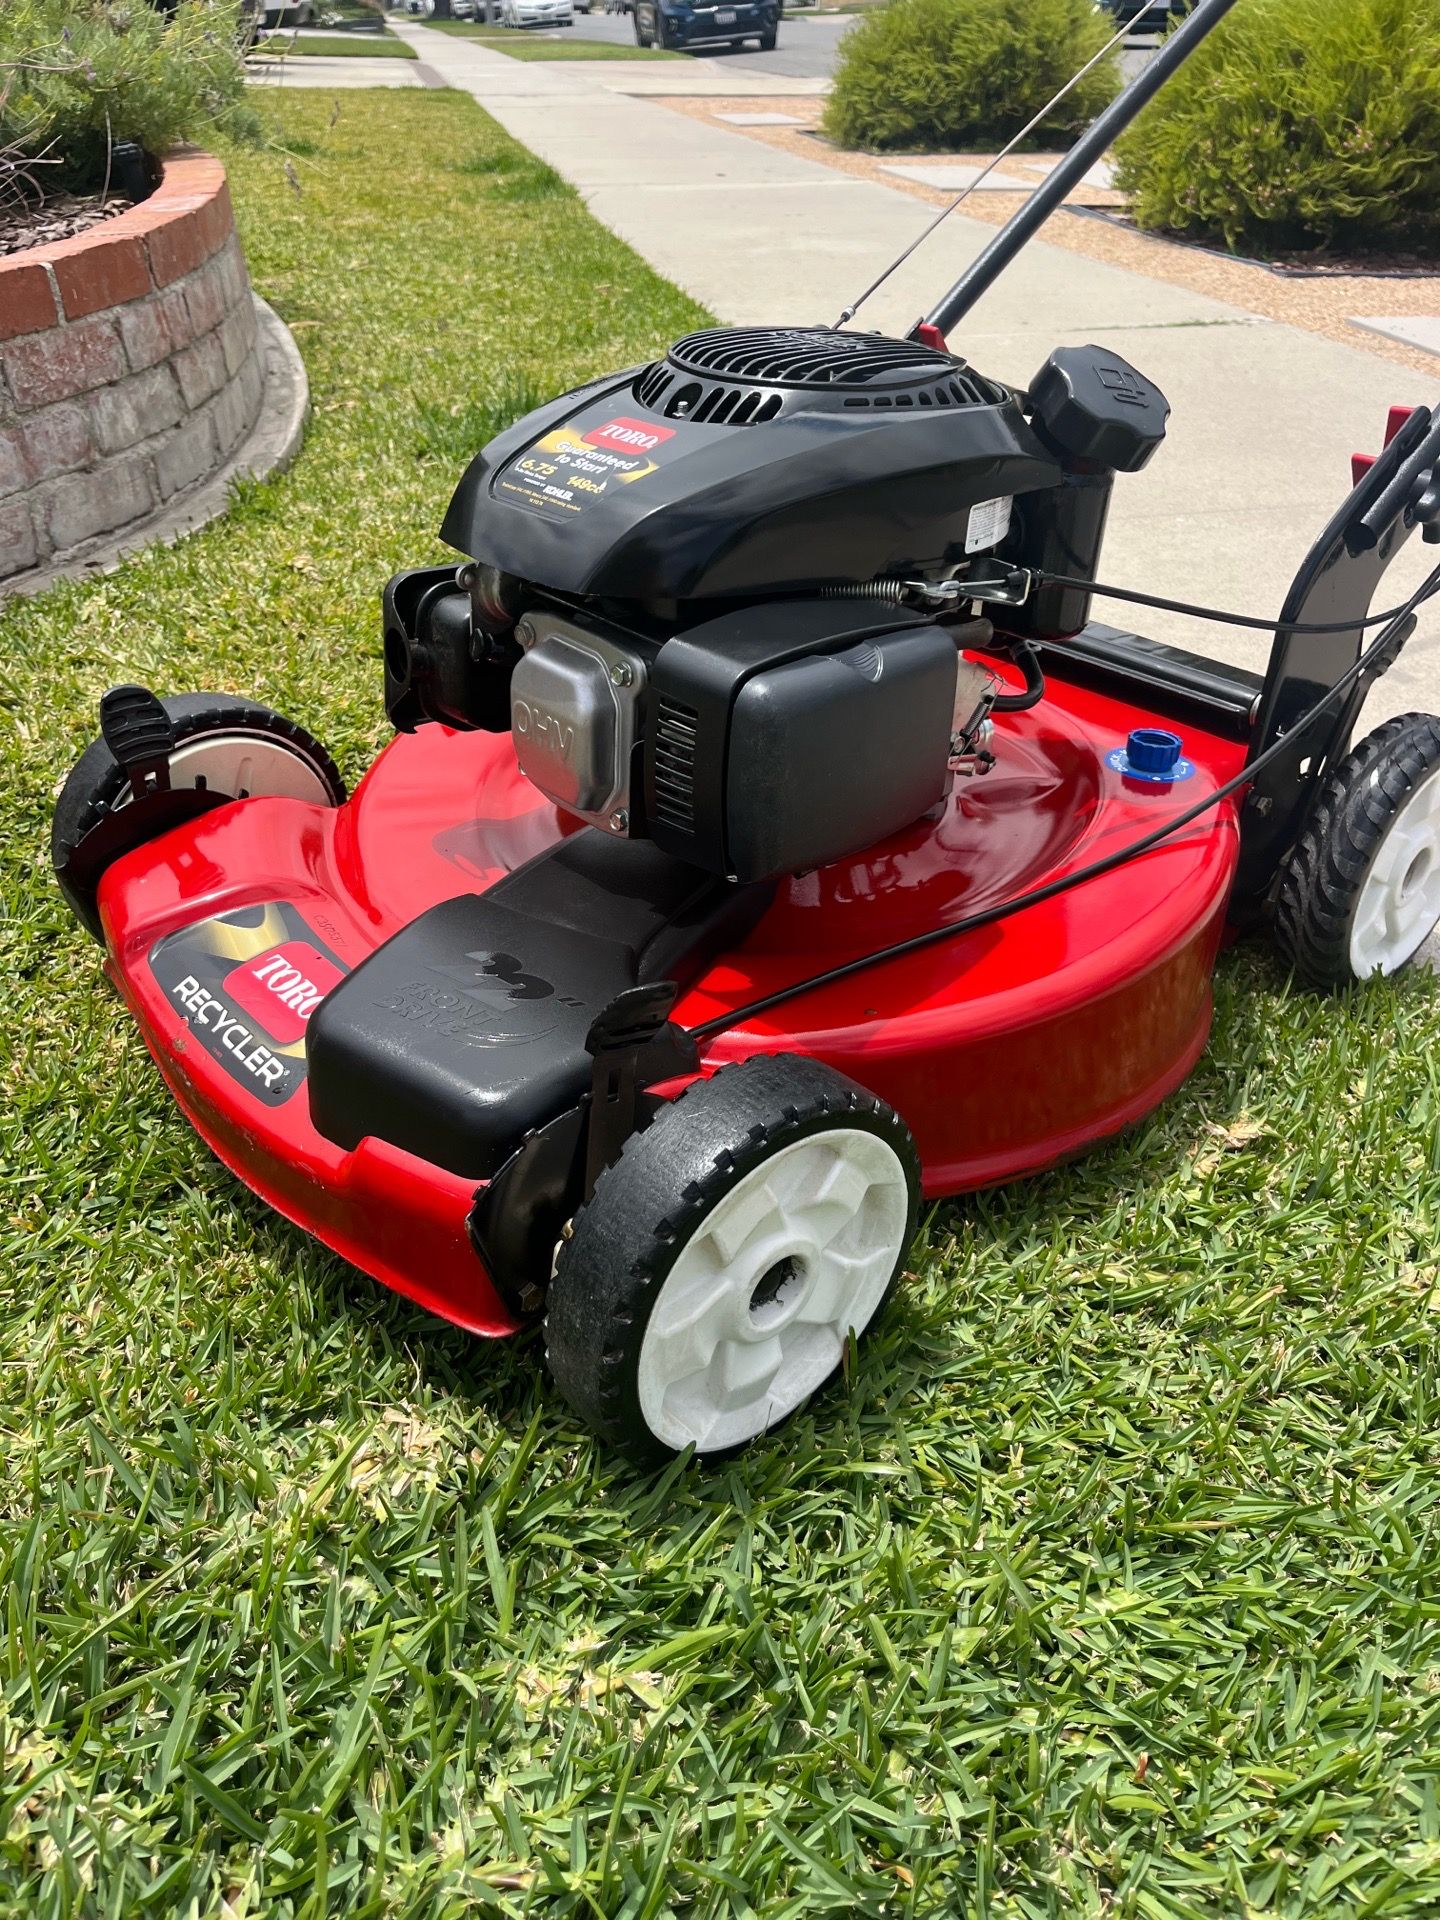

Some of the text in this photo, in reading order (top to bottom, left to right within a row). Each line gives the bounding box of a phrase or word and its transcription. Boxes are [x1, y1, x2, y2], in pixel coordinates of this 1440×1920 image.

[521, 459, 559, 475] 6.75
[554, 454, 608, 474] to Start
[555, 441, 640, 471] Guaranteed
[513, 700, 575, 761] OHV
[402, 982, 503, 1026] FRONT
